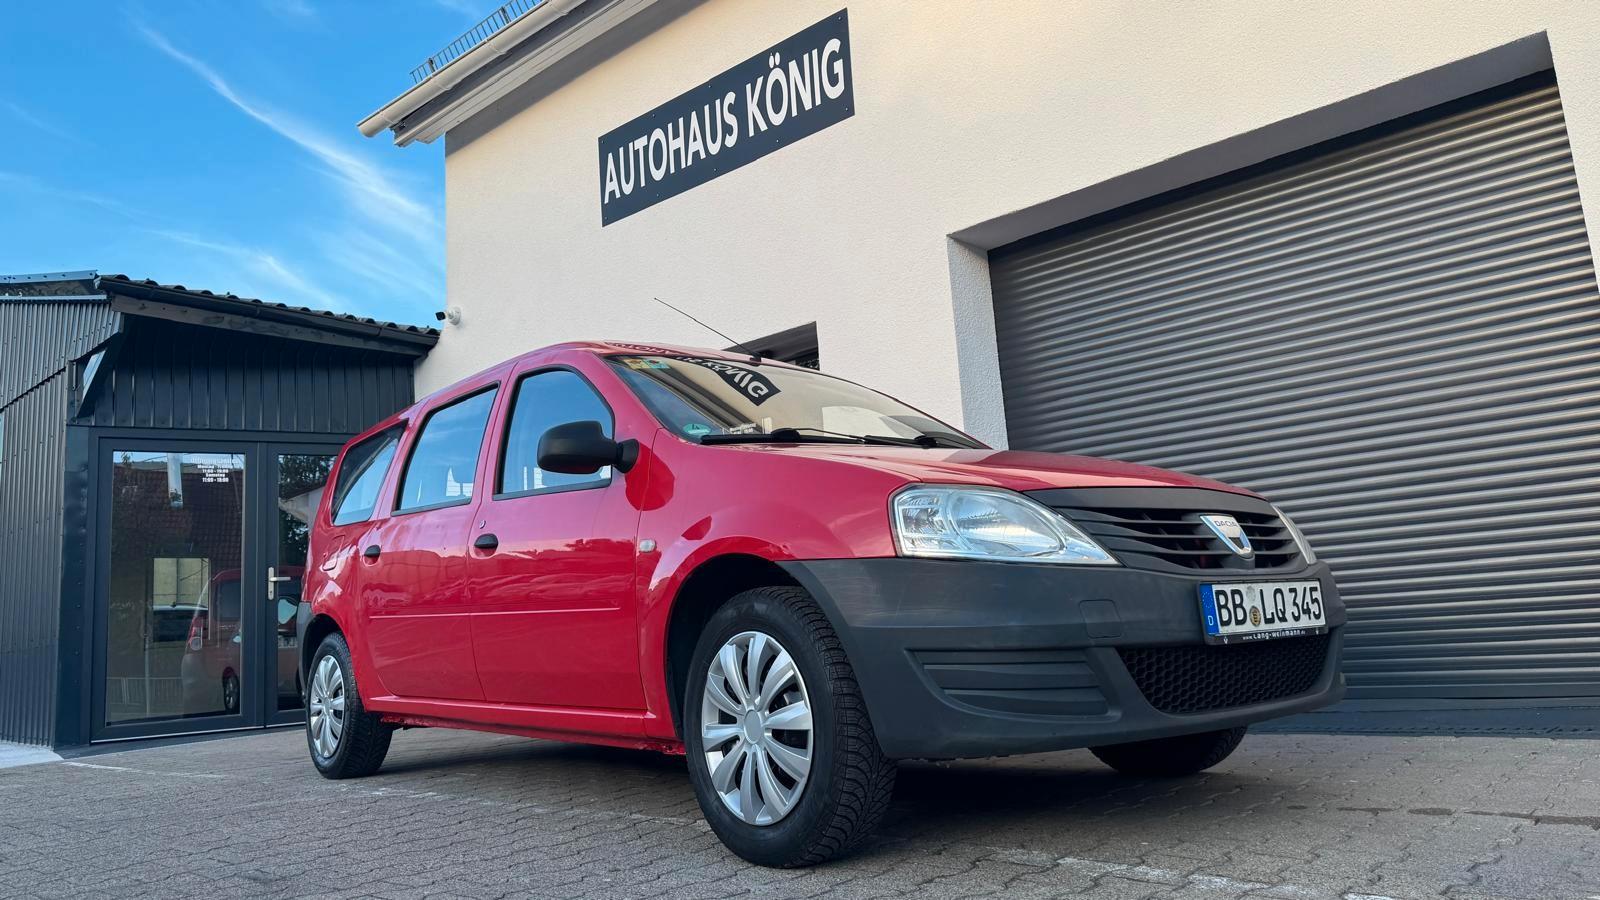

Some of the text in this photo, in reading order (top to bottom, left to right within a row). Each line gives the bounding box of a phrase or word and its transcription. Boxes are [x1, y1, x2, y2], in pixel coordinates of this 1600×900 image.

[604, 38, 845, 204] AUTOHAUS KÖNIG
[1208, 615, 1214, 626] D
[1214, 586, 1322, 627] BB LQ 345
